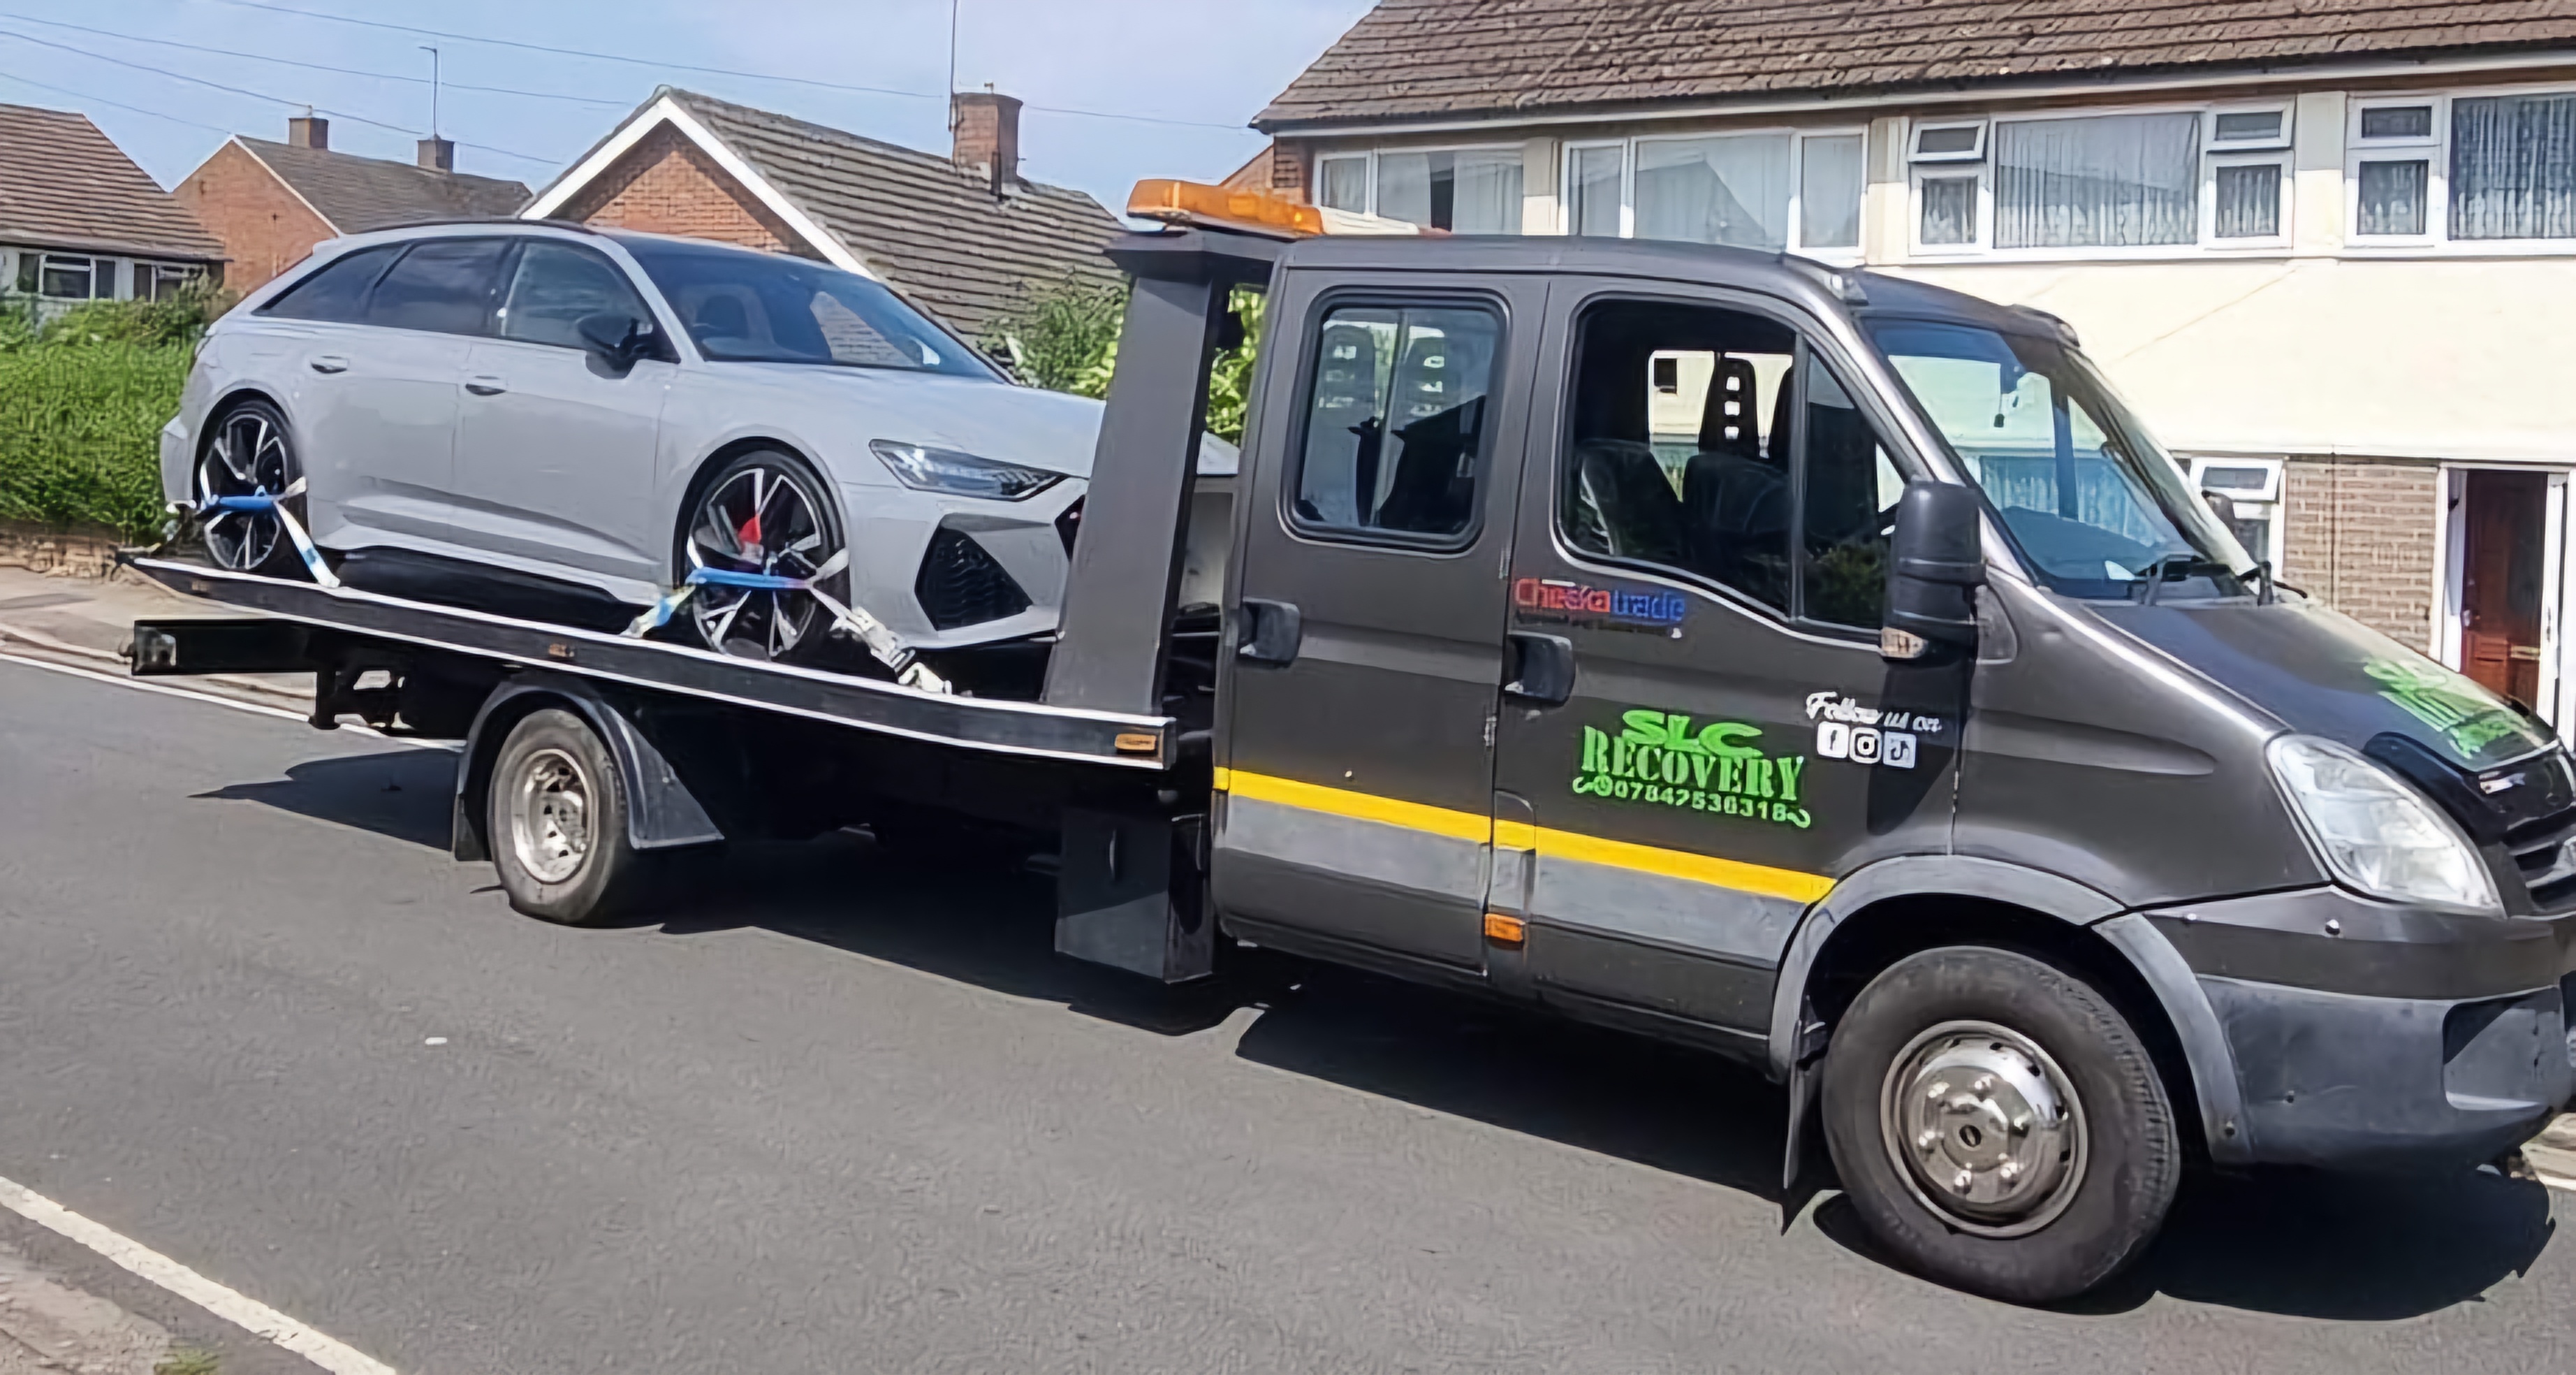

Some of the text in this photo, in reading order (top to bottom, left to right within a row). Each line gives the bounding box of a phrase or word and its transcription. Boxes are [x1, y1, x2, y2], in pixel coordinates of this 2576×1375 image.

[1806, 691, 1883, 725] Follow
[1622, 709, 1764, 758] SLC
[1581, 725, 1804, 801] RECOVERY
